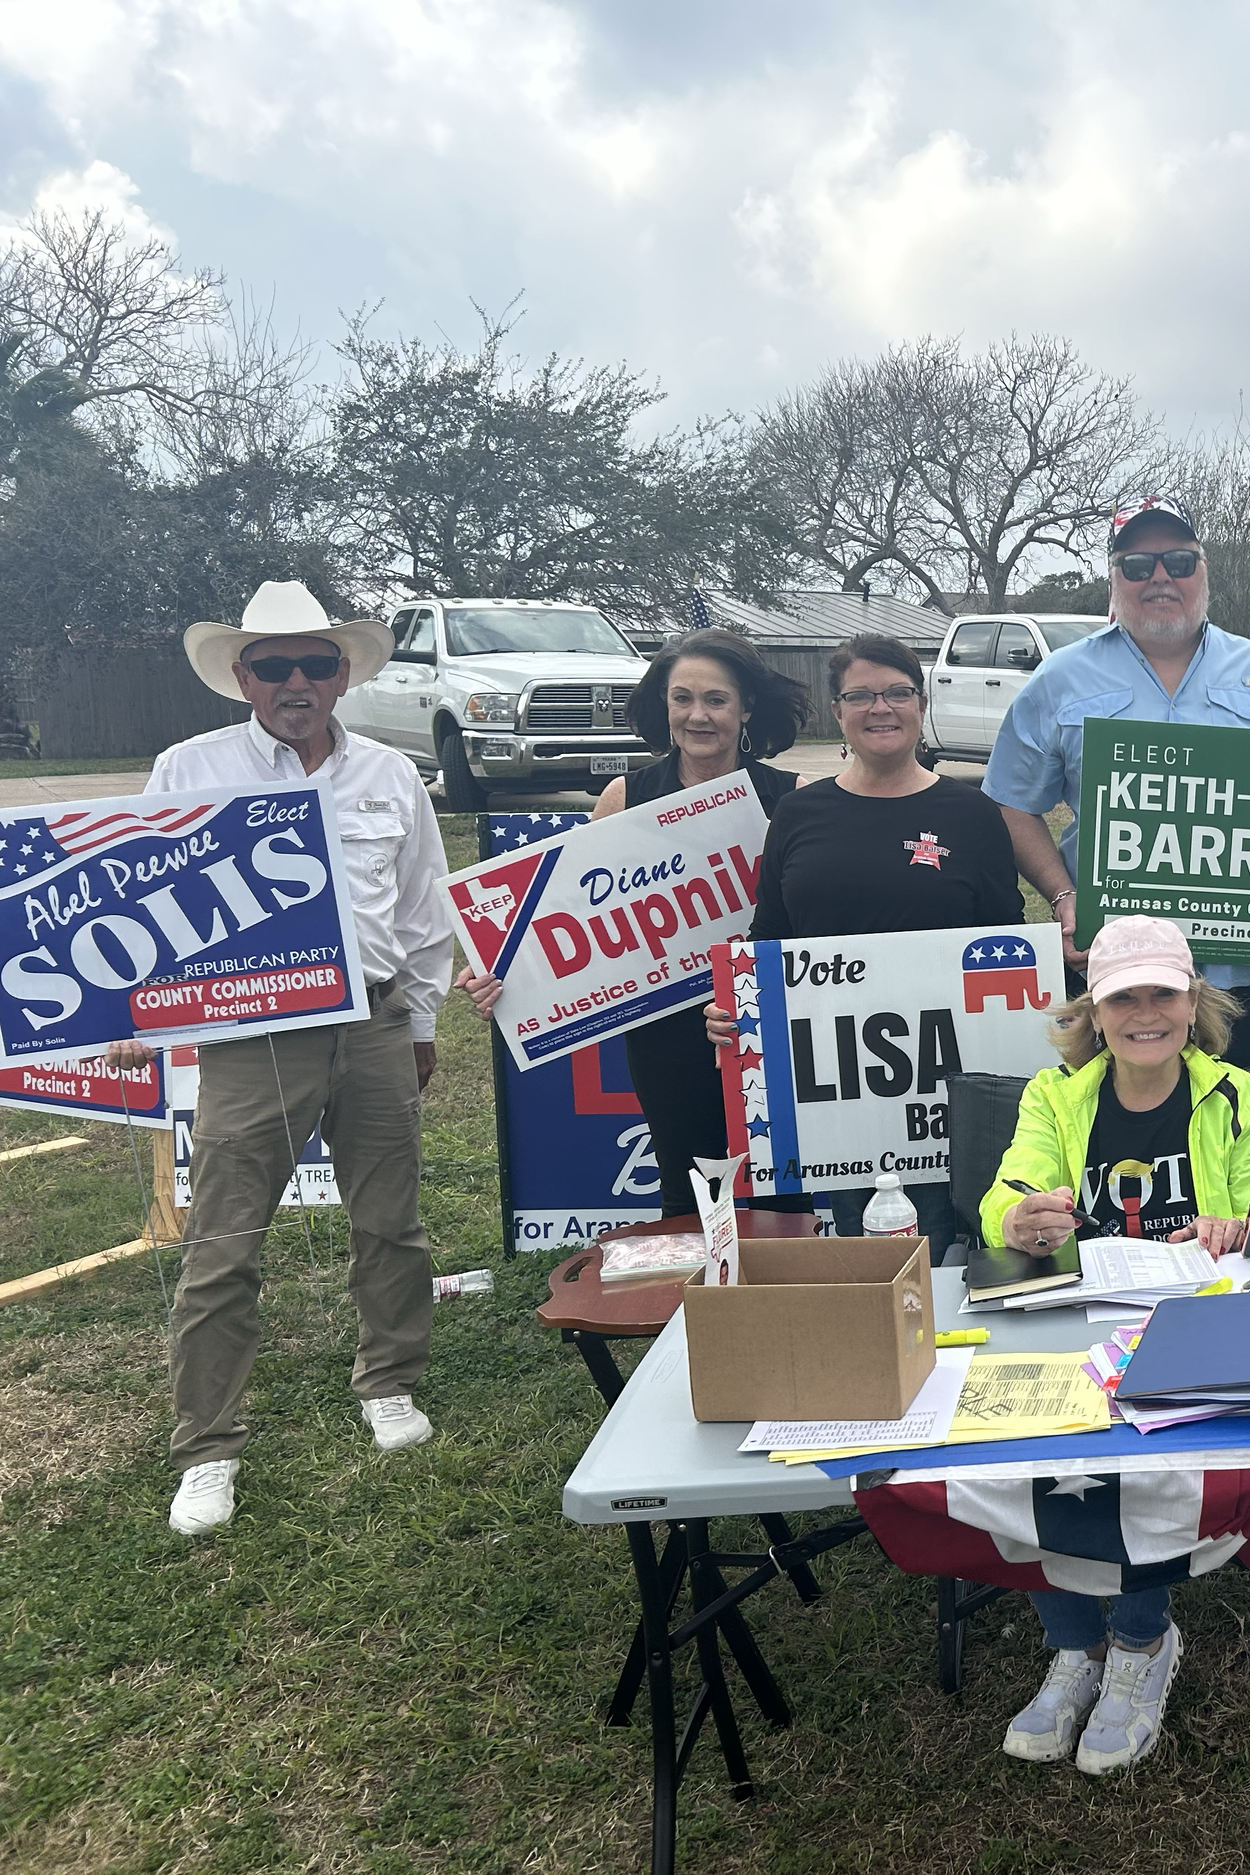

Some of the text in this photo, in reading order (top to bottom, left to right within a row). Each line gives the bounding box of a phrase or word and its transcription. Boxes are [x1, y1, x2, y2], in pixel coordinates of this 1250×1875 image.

[1113, 743, 1194, 766] ELECT
[656, 785, 748, 827] REPUBLICAN
[1109, 771, 1235, 816] KEITH
[246, 799, 310, 827] Elect
[905, 842, 921, 850] Lisa
[920, 832, 938, 843] VOTE
[24, 830, 220, 941] Abel Peewee
[580, 853, 686, 906] Diane
[1105, 875, 1125, 889] for
[469, 894, 513, 918] KEEP
[1099, 894, 1172, 911] Aransas
[1178, 897, 1241, 917] County
[1, 826, 328, 1031] SOLIS
[1109, 940, 1165, 955] TRUMP
[184, 946, 339, 978] REPUBLICAN PARTY
[782, 949, 866, 988] Vote
[136, 968, 337, 1010] COUNTY COMMISSIONER
[143, 974, 187, 987] FOR
[548, 979, 638, 1023] Justice
[646, 962, 670, 985] of
[204, 996, 278, 1019] Precinct 2
[11, 1036, 66, 1050] Paid By Solis
[790, 1008, 963, 1104] LISA
[23, 1072, 91, 1097] Precinct 2
[905, 1103, 949, 1142] Ba
[176, 1172, 189, 1186] fo
[744, 1162, 779, 1184] For
[783, 1158, 873, 1181] Aransas
[1080, 1153, 1188, 1215] VOT
[514, 1216, 554, 1239] for
[618, 1499, 661, 1508] LIFETIME
